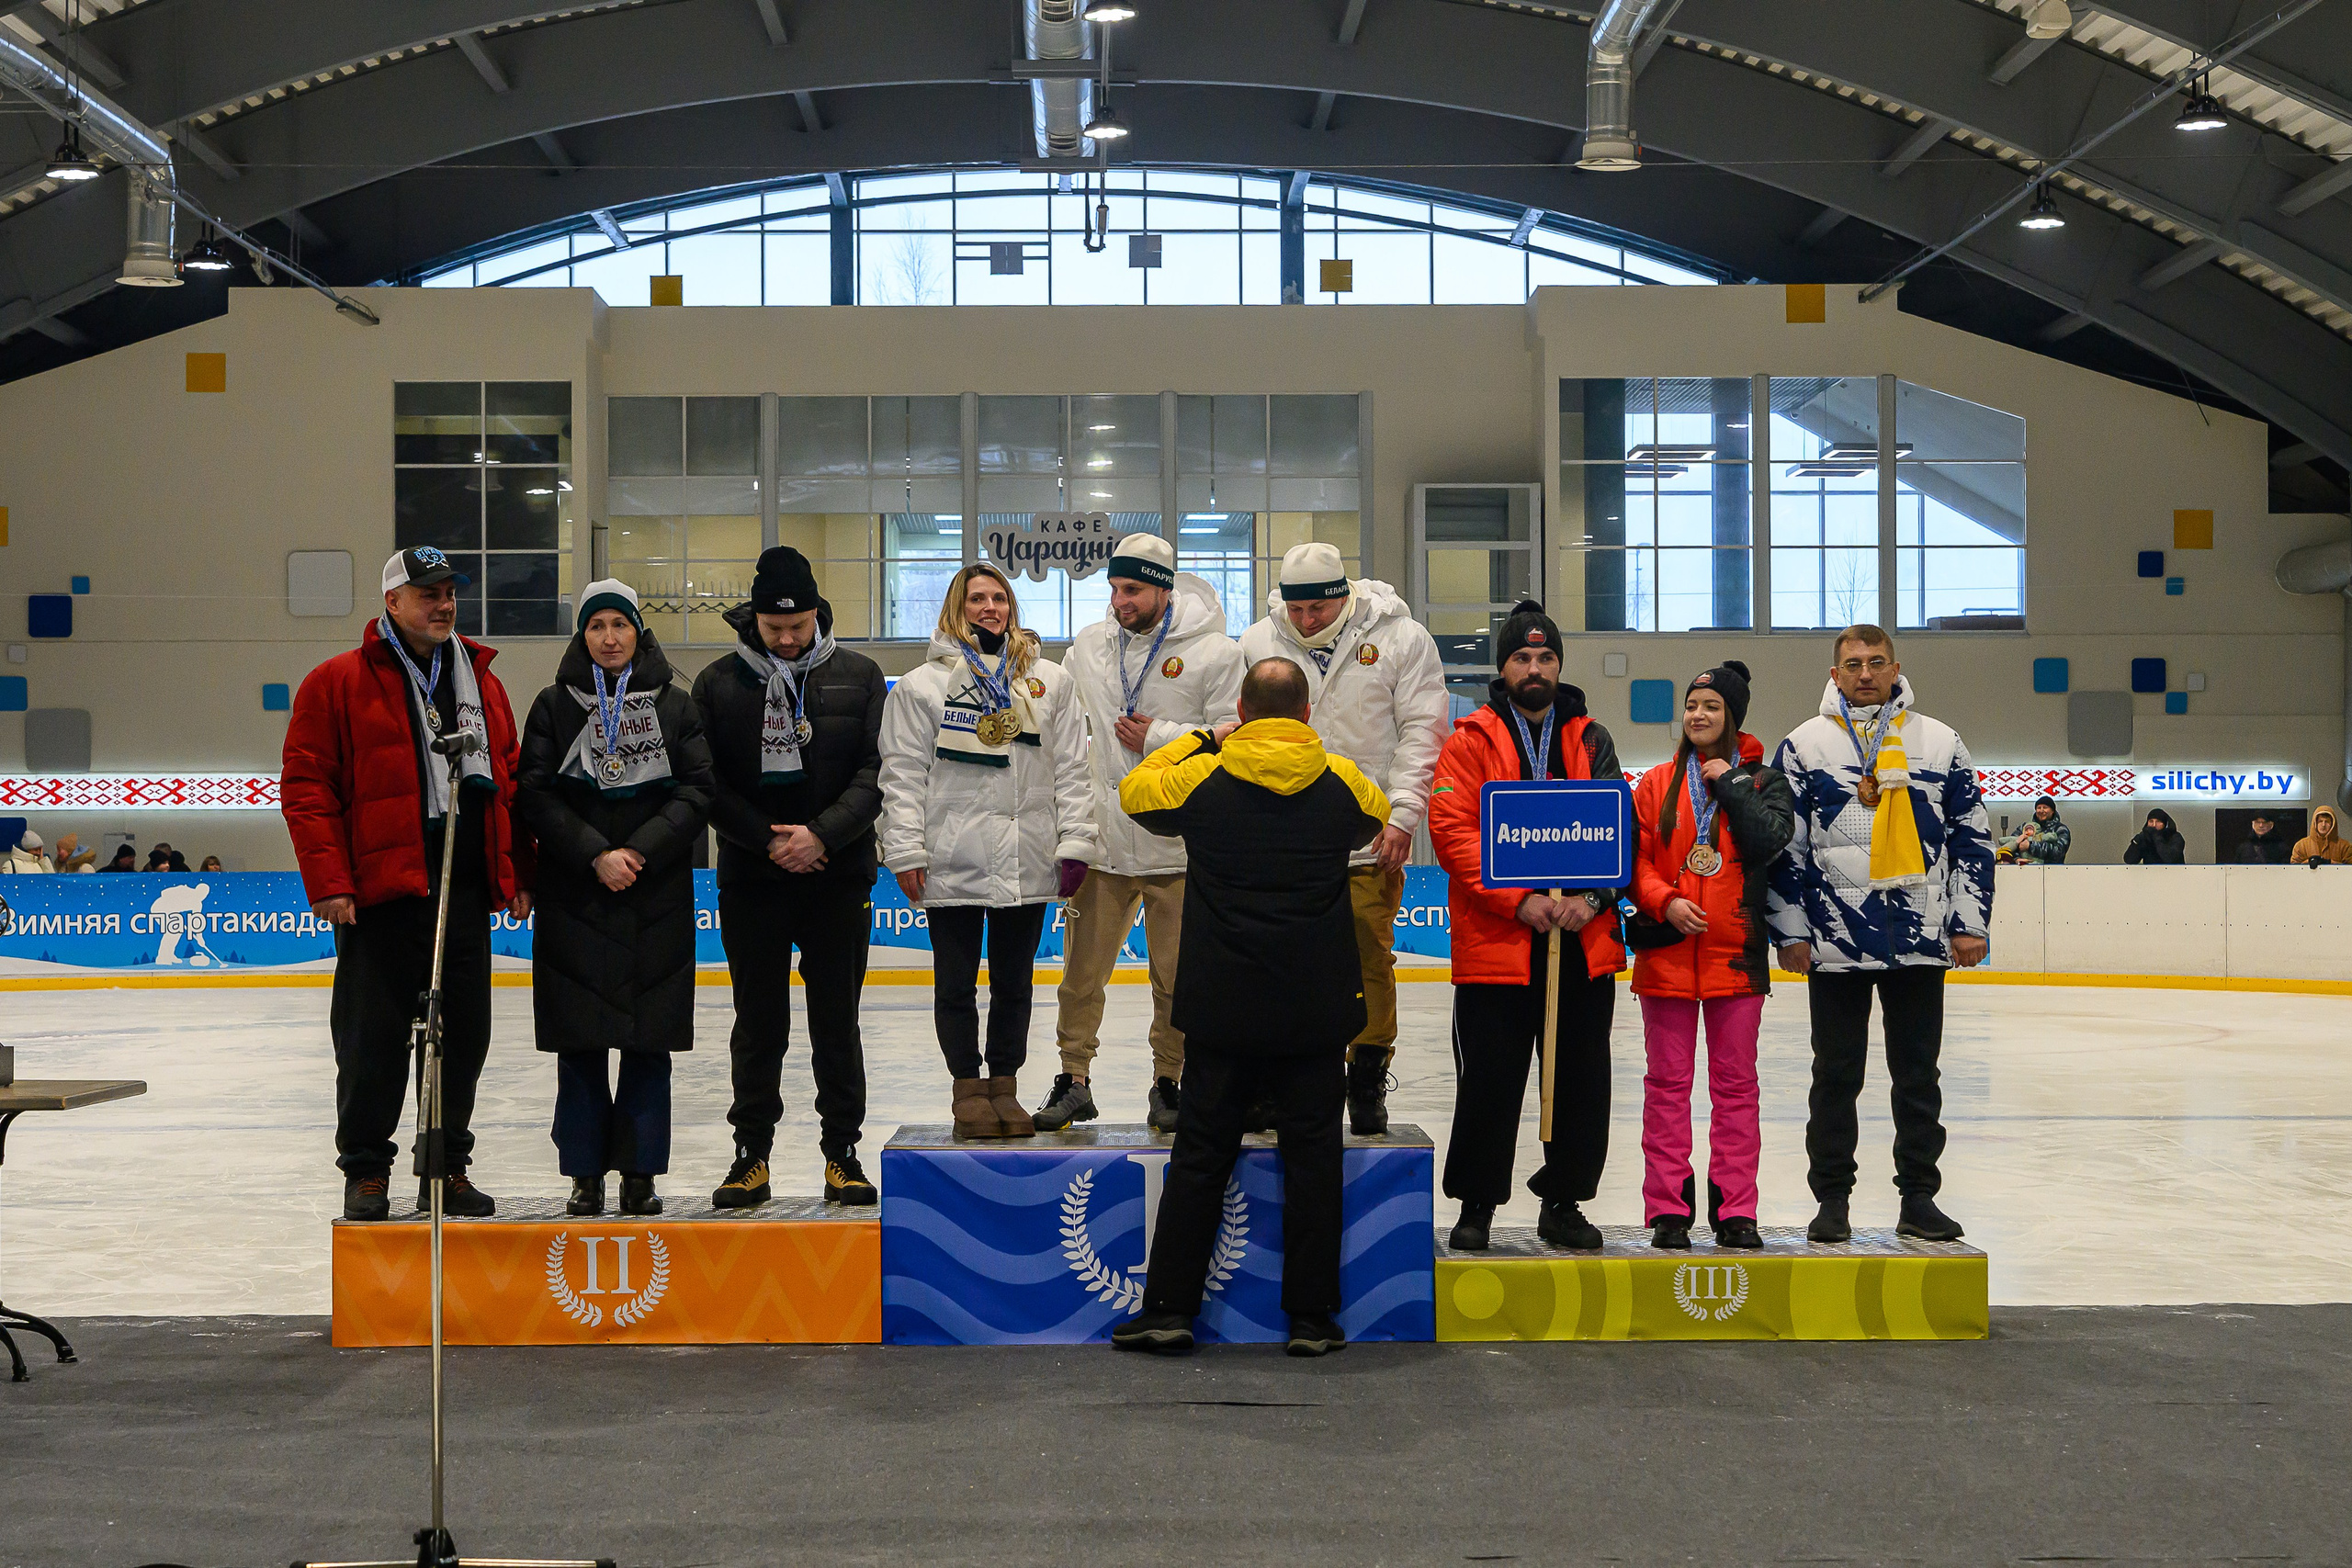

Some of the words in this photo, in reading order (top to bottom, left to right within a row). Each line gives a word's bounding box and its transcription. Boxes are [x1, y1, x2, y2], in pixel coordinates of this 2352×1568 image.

[1041, 520, 1102, 533] КАФЕ
[989, 532, 1121, 574] Чараўні
[594, 716, 653, 739] ЕИНЫЕ
[763, 716, 786, 731] НЫЕ
[2152, 771, 2294, 795] silichy.by
[1497, 820, 1614, 849] Агрохолдинг
[130, 911, 333, 941] спартакиада
[579, 1236, 636, 1294] II
[1687, 1266, 1738, 1299] III
